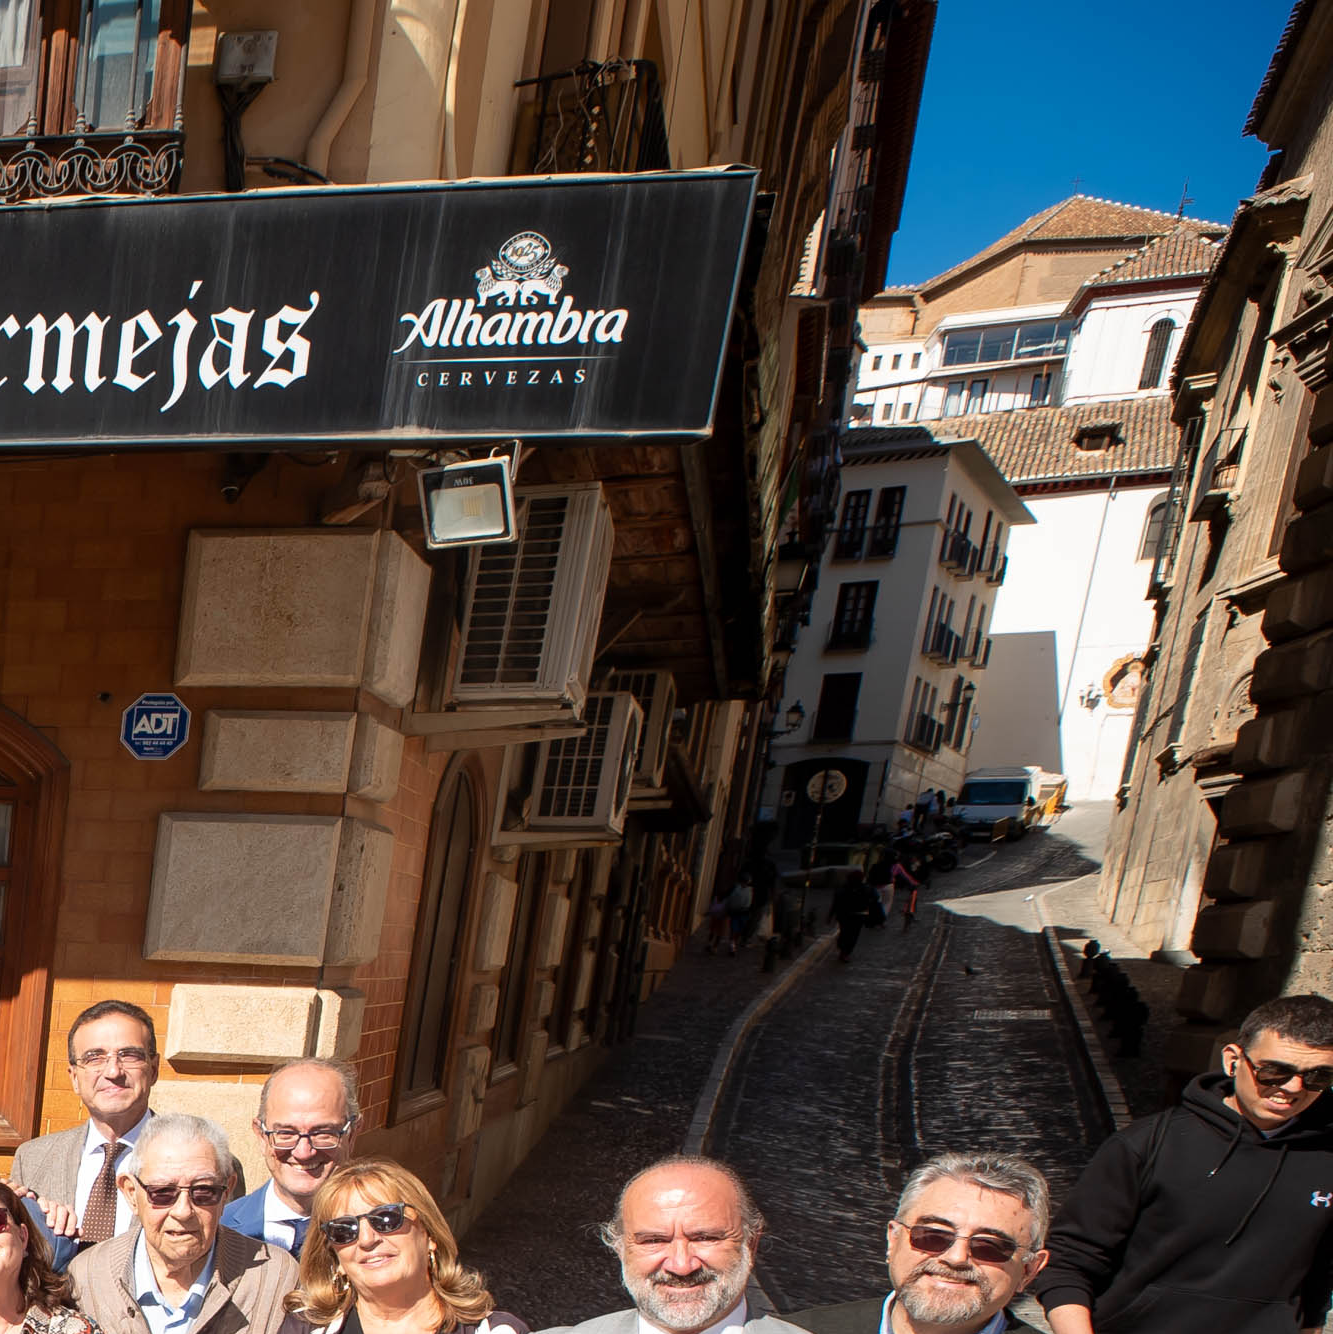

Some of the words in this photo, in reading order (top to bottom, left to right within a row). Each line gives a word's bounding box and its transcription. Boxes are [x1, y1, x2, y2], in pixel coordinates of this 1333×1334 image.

[393, 294, 630, 354] Alhambra
[416, 368, 588, 388] CERVEZAS
[133, 713, 178, 734] ADT
